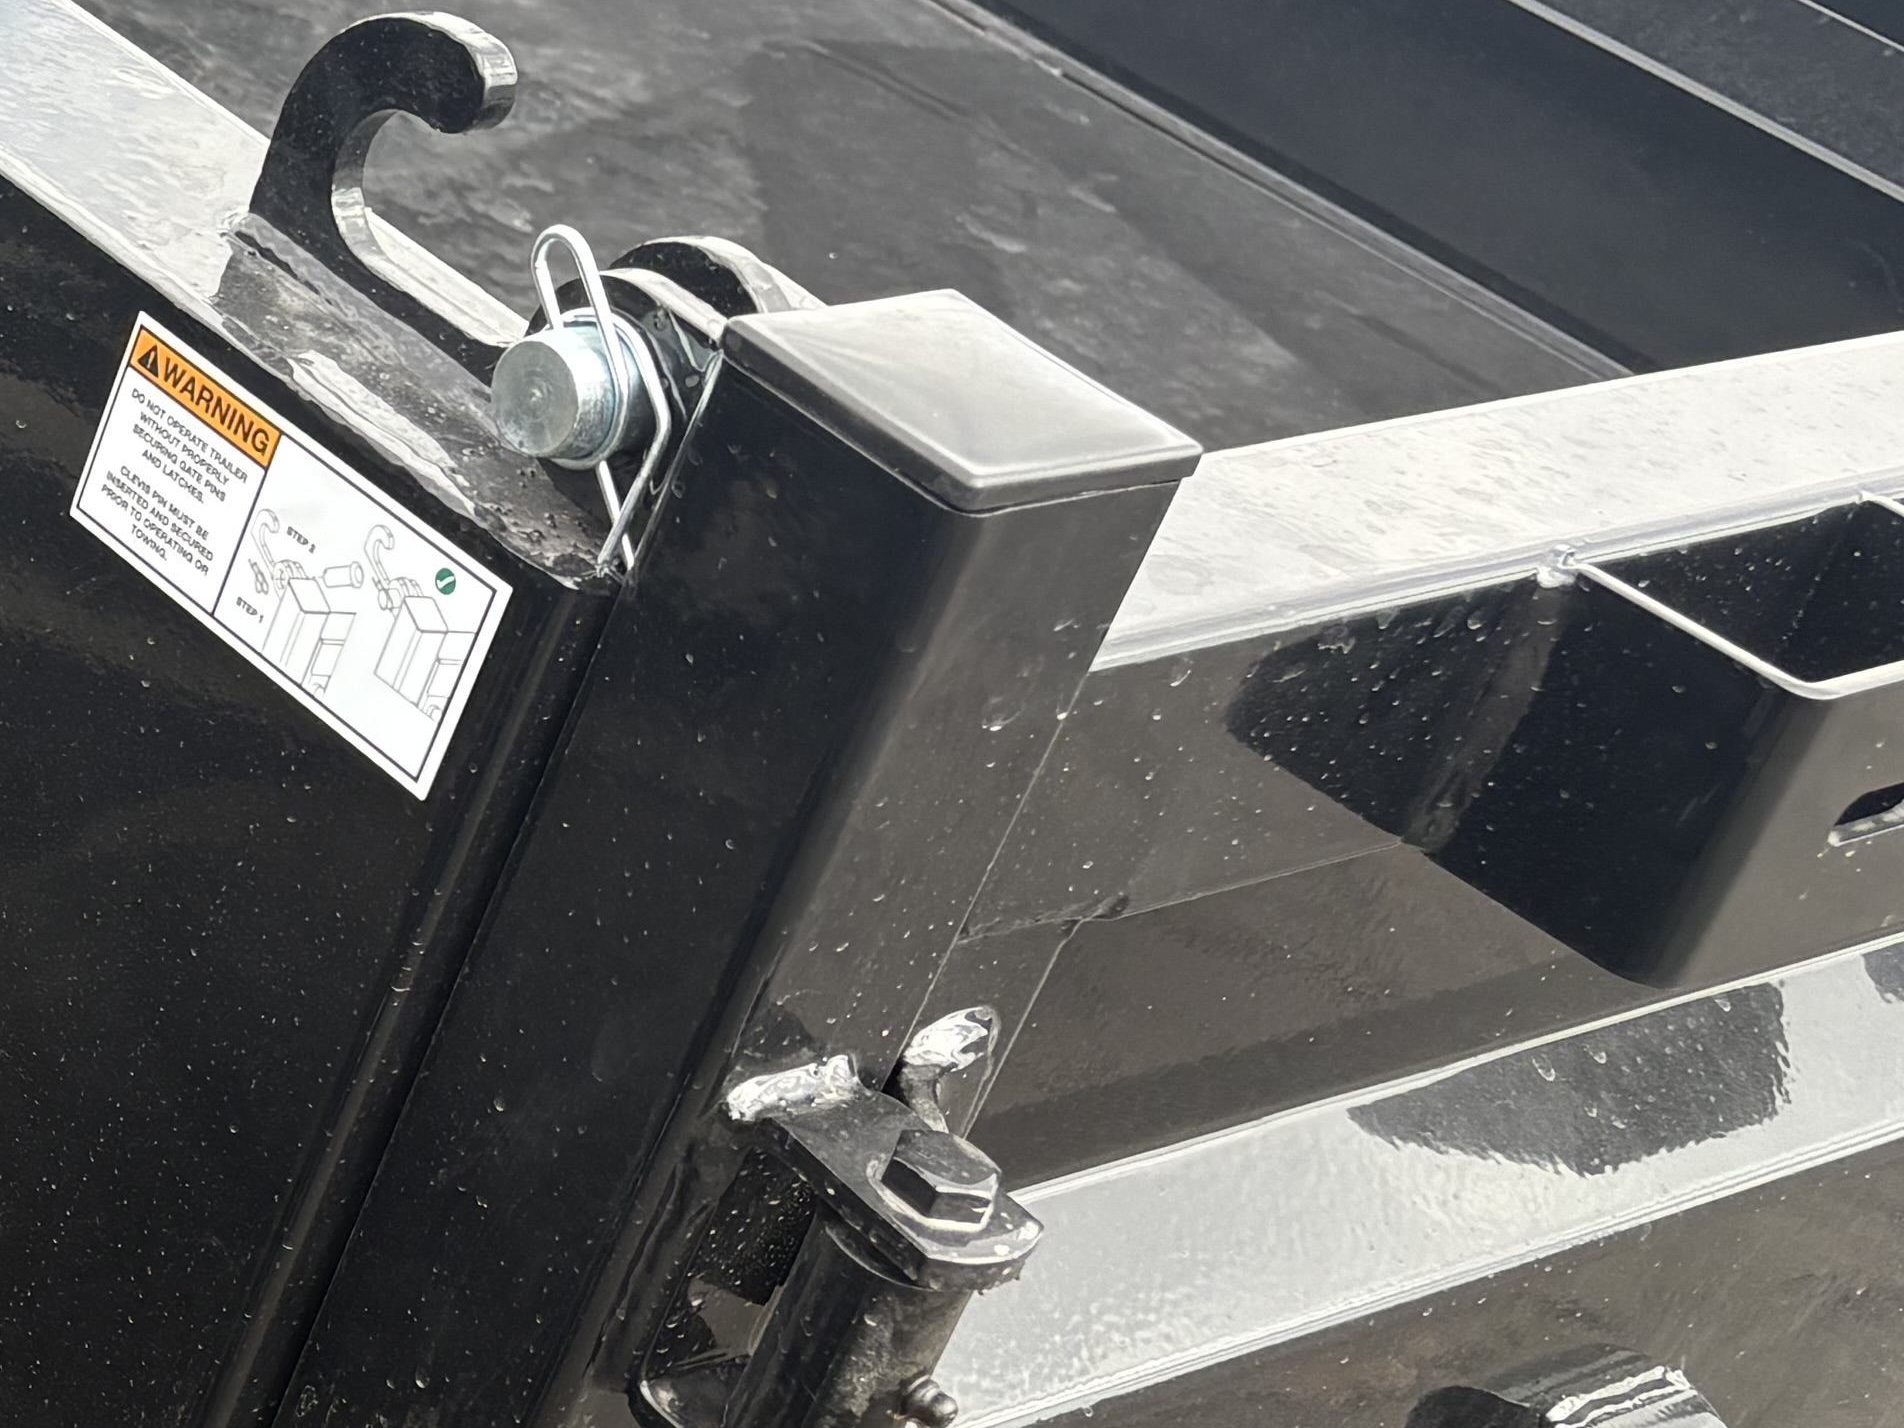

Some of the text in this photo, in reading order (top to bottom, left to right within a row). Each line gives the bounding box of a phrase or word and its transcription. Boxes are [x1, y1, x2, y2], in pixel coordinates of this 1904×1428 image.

[132, 388, 248, 483] DO NOT OPERATE TRAILER
[163, 357, 270, 457] WARNING
[132, 423, 178, 465] SECURING
[179, 460, 203, 484] GATE
[140, 411, 229, 485] WITHOUT PROPERLY
[141, 449, 162, 468] AND
[101, 483, 209, 576] PRIOR TO OPERATING OR
[149, 507, 169, 526] AND
[170, 523, 213, 561] SECURED
[168, 503, 195, 528] MUST
[195, 525, 209, 541] BE
[286, 526, 309, 546] STEP
[235, 596, 265, 624] STEP 1
